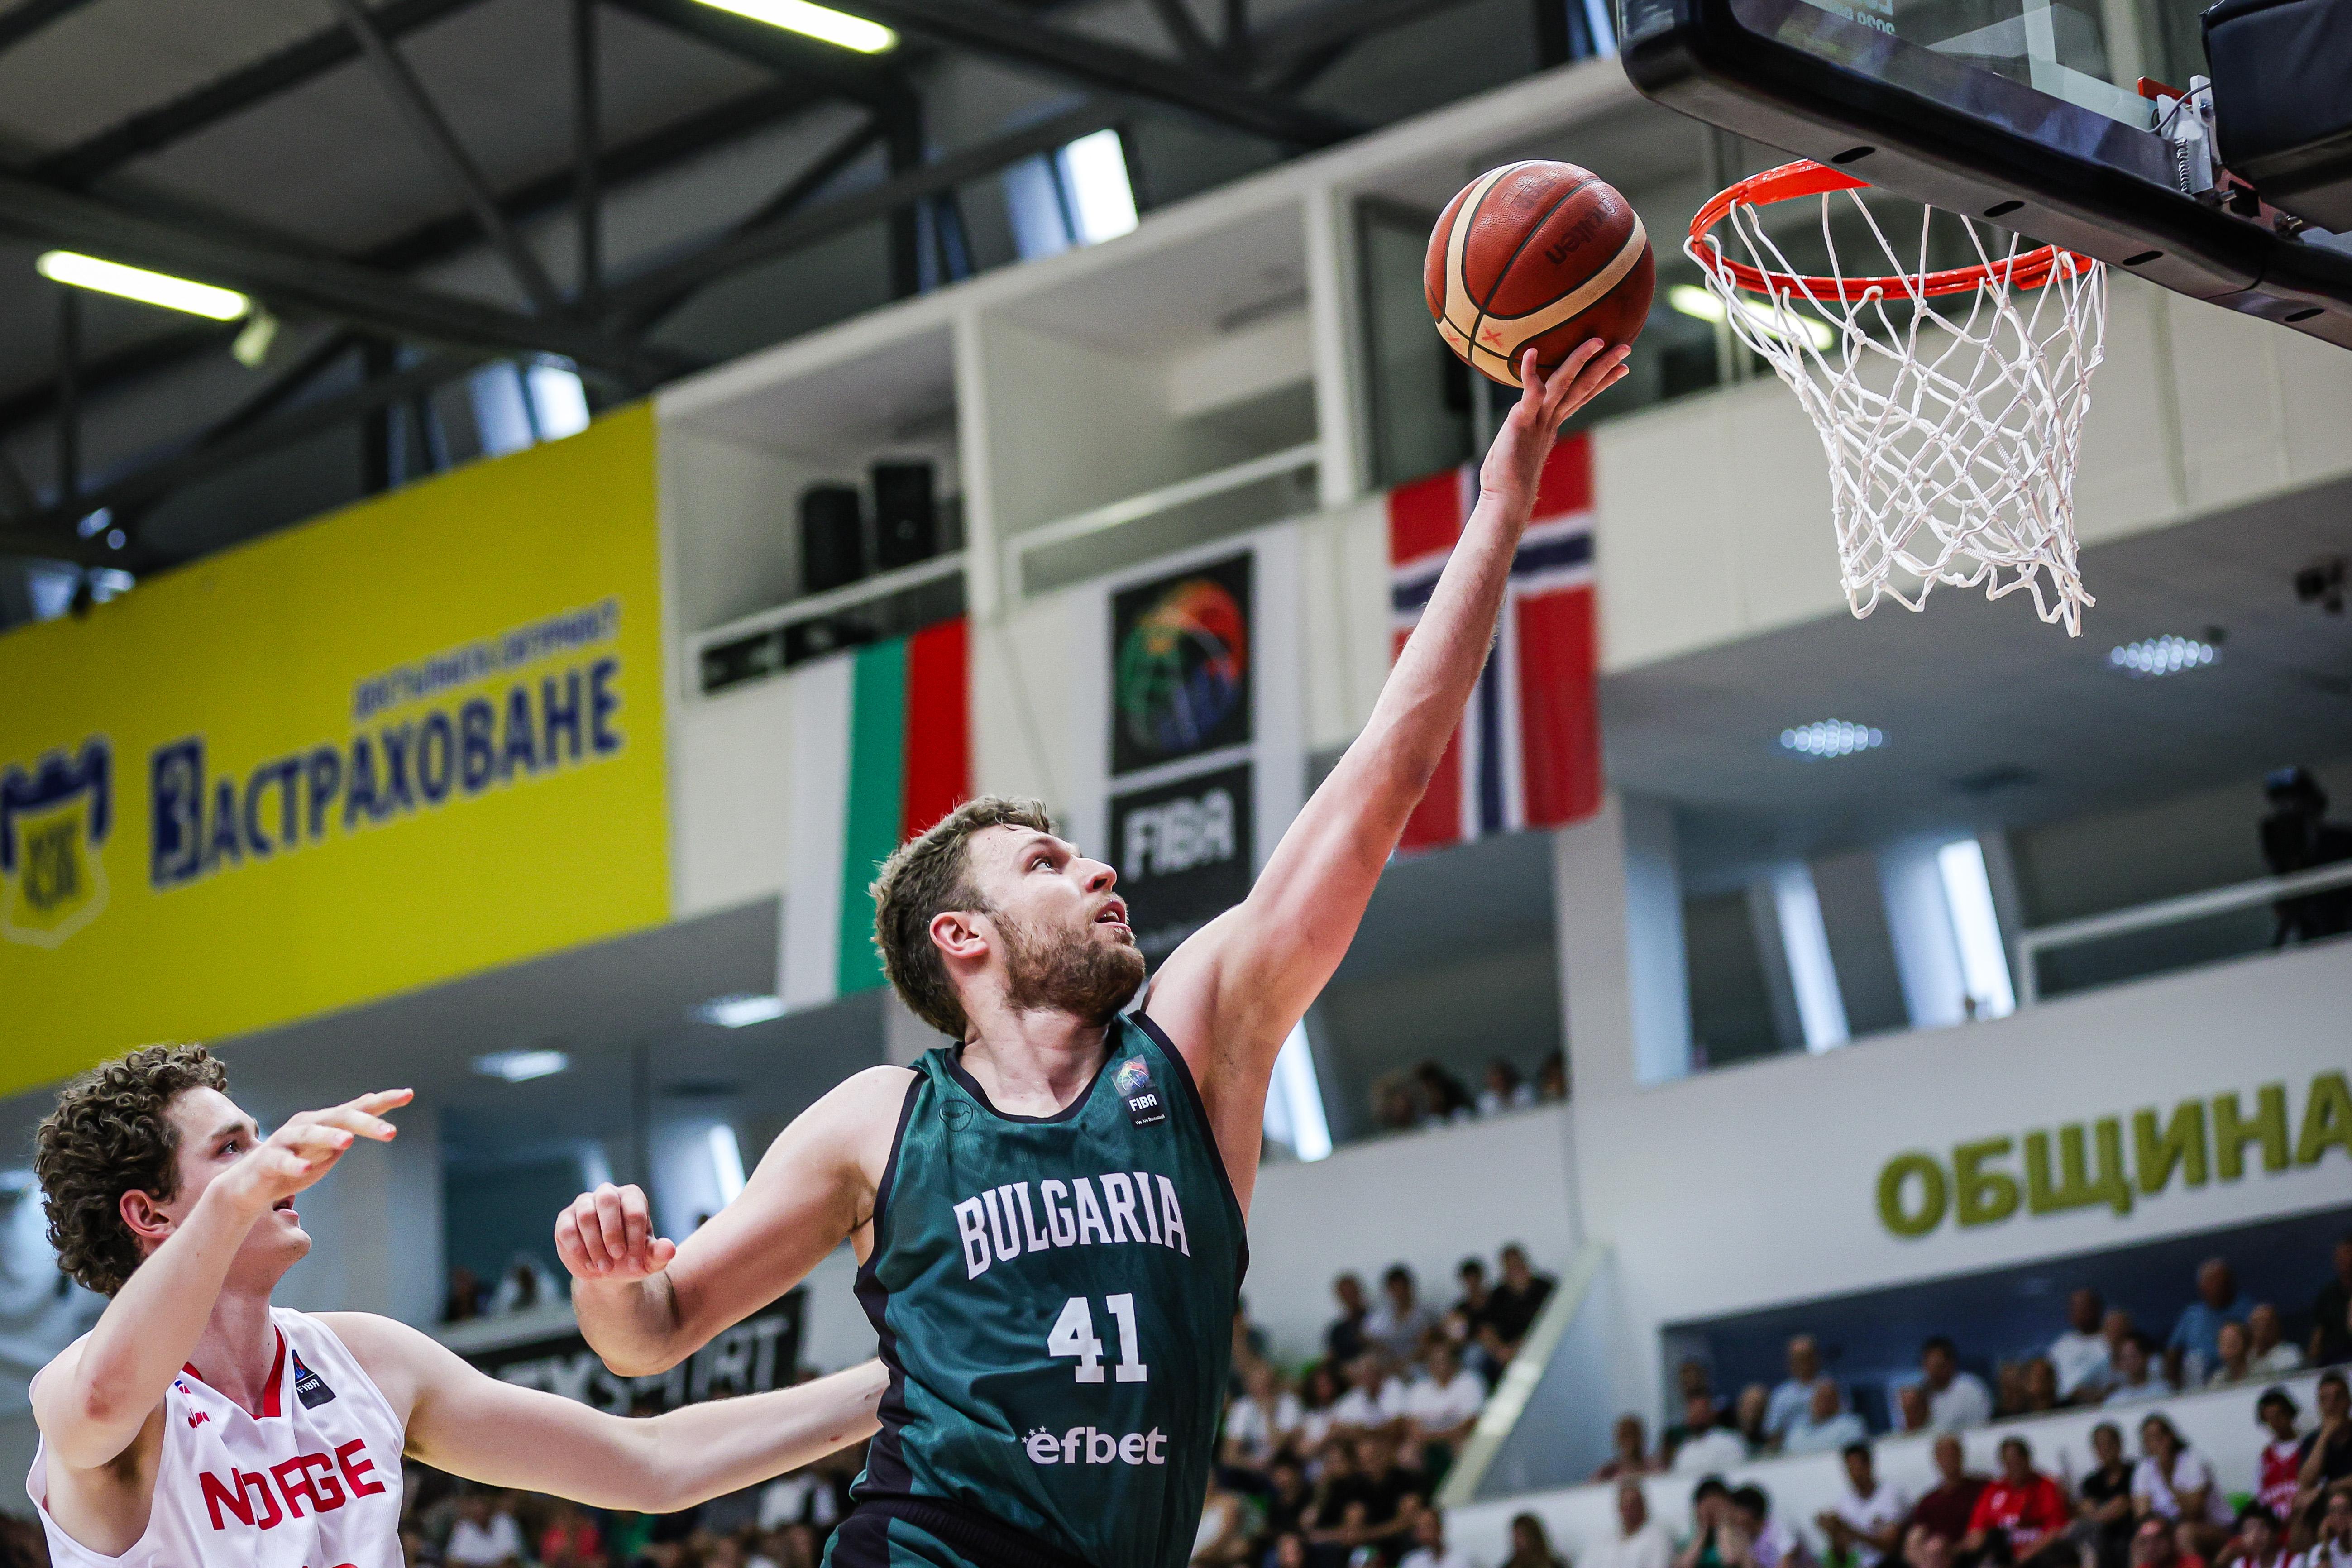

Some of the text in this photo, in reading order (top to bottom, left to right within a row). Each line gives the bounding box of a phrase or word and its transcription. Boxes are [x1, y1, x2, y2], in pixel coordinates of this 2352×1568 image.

[1123, 789, 1235, 880] FIBA
[1129, 1094, 1157, 1112] FIBA
[1877, 1069, 2352, 1239] ОБЩИНА
[952, 1171, 1190, 1281] BULGARIA
[1047, 1292, 1147, 1384] 41
[296, 1378, 320, 1394] FIBA
[1026, 1426, 1167, 1465] efbet
